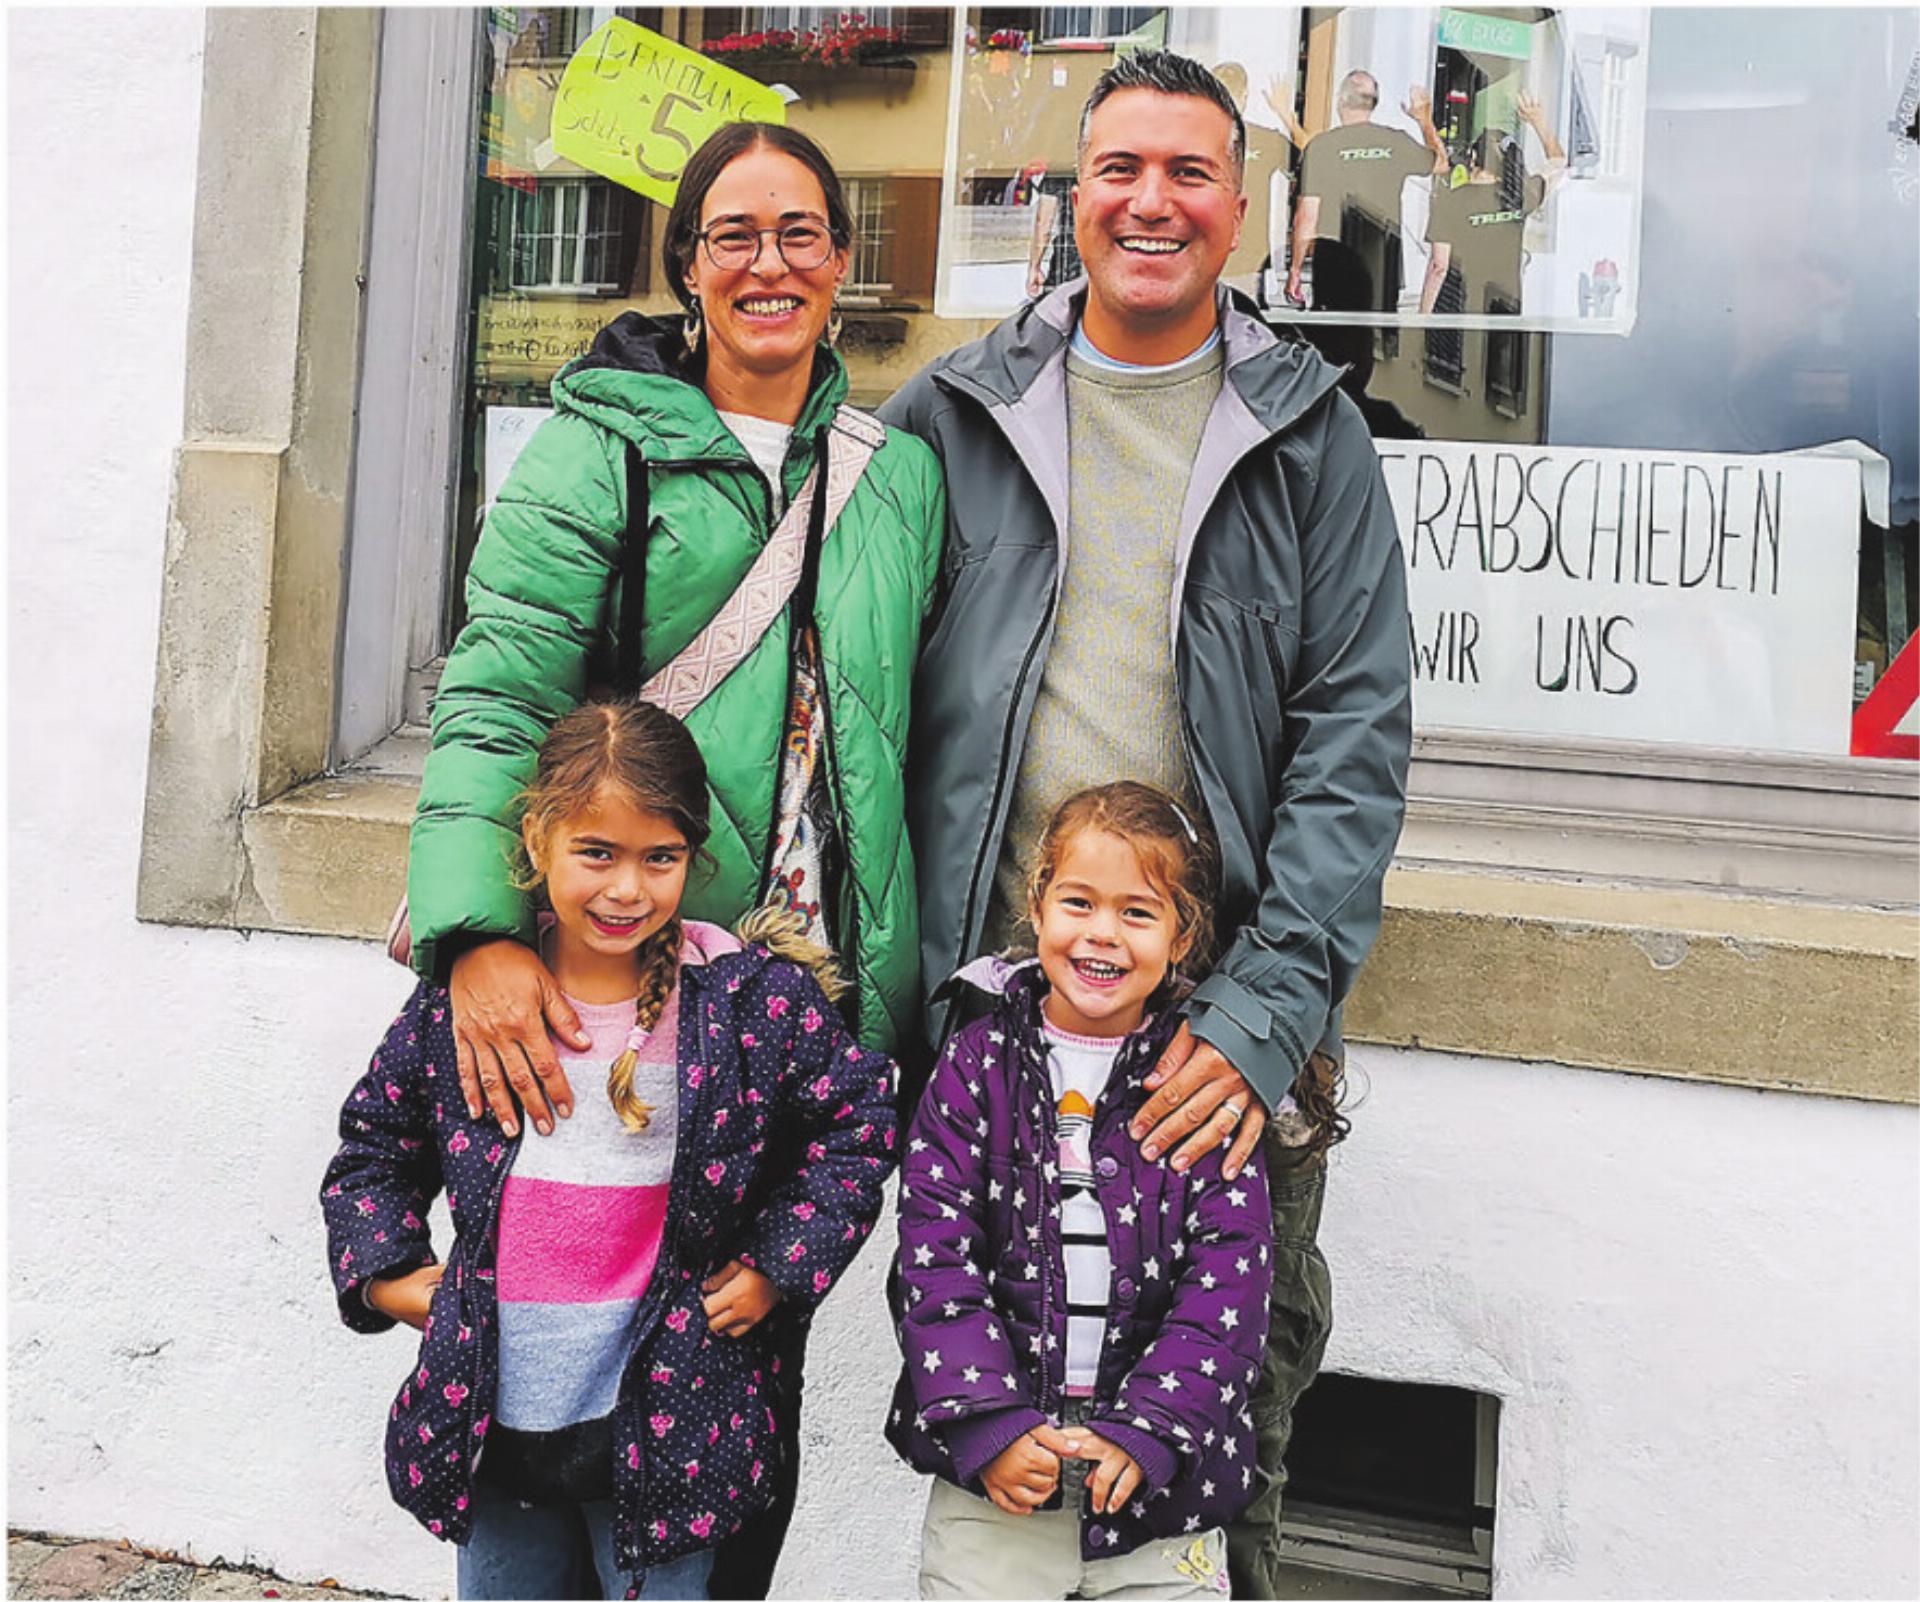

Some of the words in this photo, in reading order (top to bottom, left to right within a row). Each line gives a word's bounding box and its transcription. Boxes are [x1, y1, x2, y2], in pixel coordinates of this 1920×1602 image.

[1338, 147, 1393, 161] TREK
[1468, 209, 1522, 226] TREK
[1407, 611, 1481, 684] WIR
[1536, 614, 1638, 695] UNS
